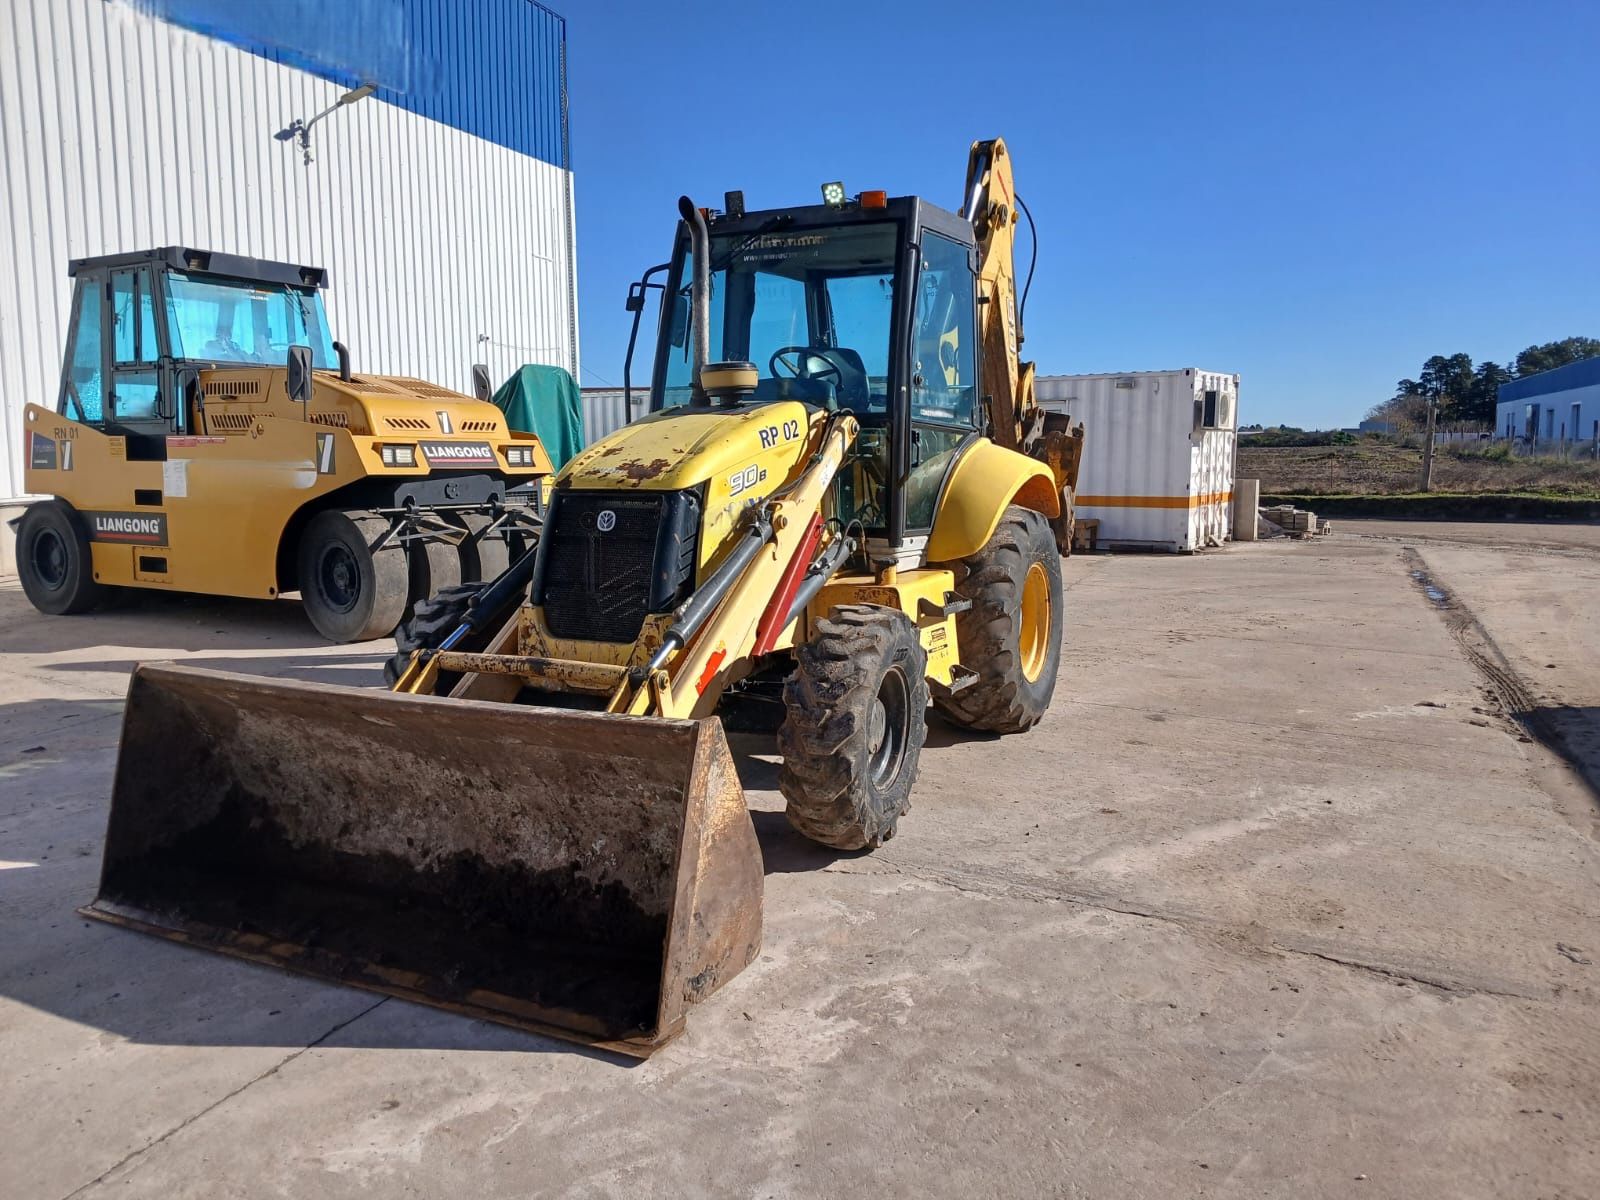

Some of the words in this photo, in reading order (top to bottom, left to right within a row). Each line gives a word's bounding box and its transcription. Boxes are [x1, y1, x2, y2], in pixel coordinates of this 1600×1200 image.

[54, 427, 67, 439] RN
[69, 427, 79, 439] 01
[758, 426, 779, 449] RP
[783, 420, 799, 441] 02
[423, 446, 491, 458] LIANGONG
[95, 517, 160, 533] LIANGONG
